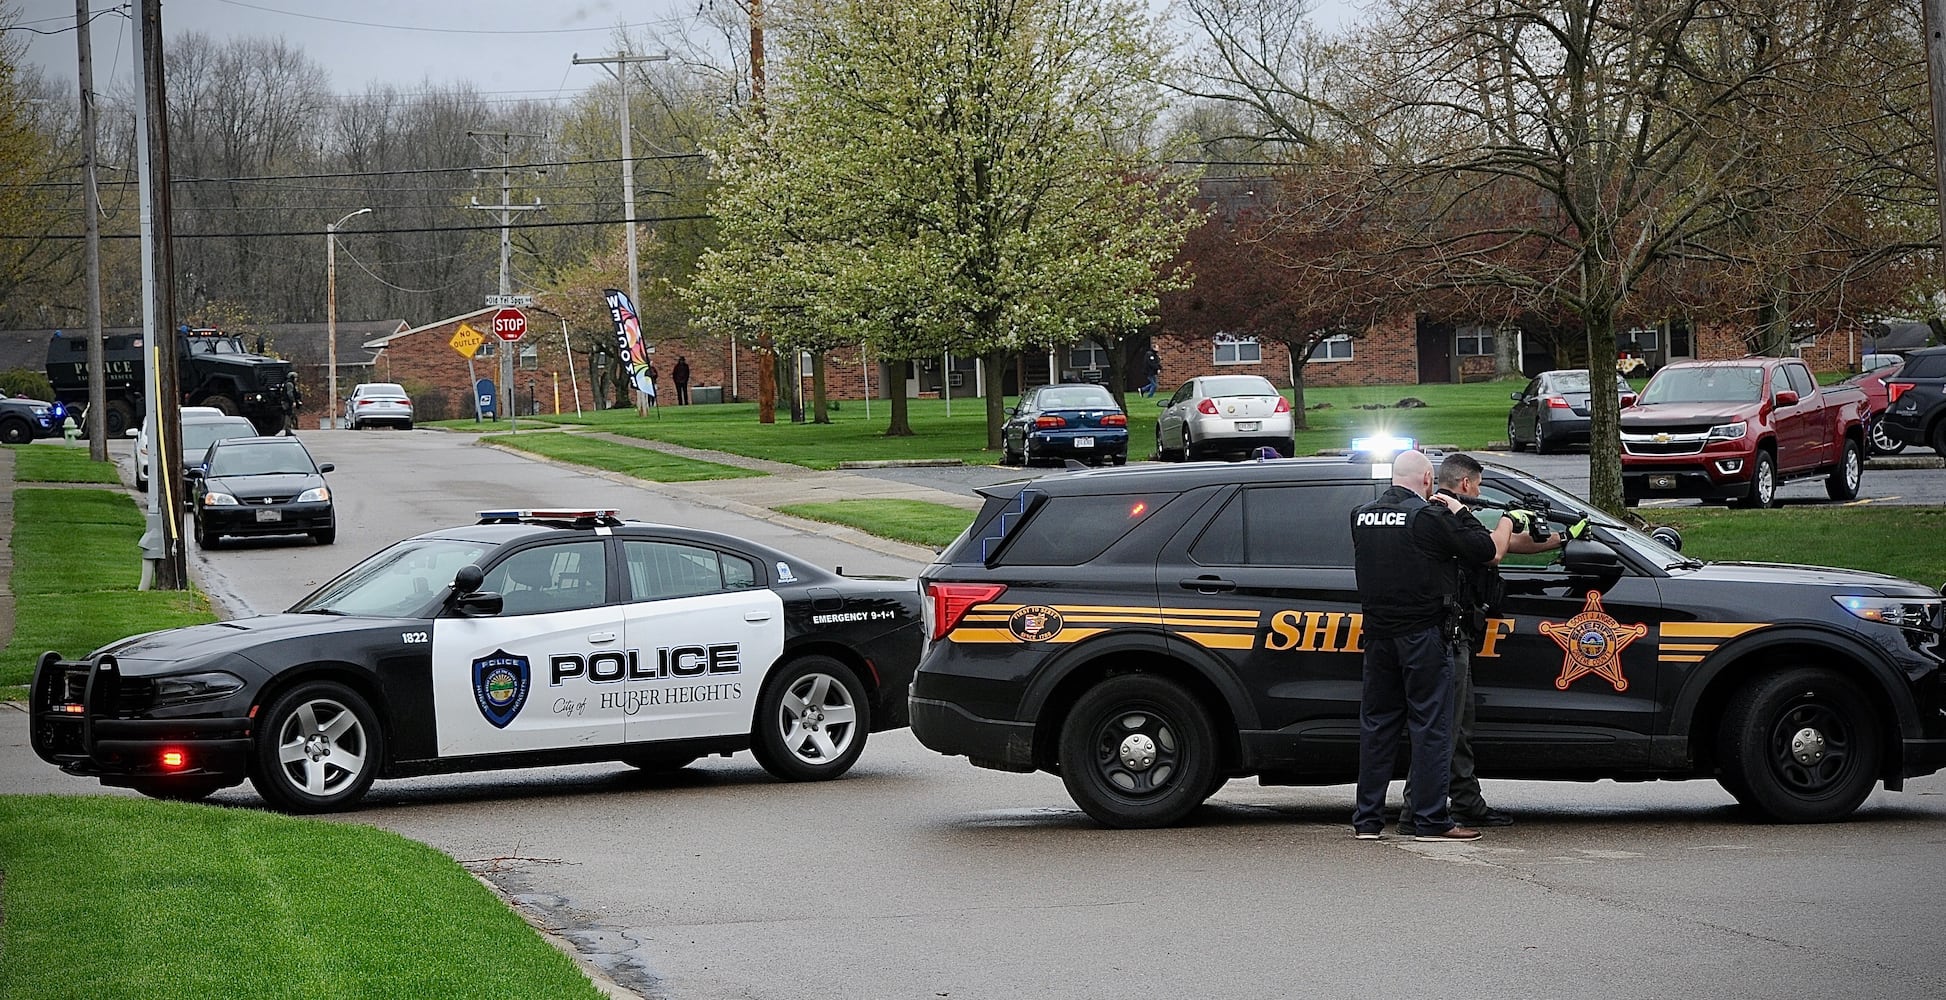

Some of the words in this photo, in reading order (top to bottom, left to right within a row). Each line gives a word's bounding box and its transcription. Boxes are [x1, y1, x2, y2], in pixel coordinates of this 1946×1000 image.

[495, 318, 524, 331] STOP
[453, 338, 480, 348] OUTLET
[74, 361, 132, 374] PICE
[1356, 512, 1407, 526] POLICE
[812, 612, 868, 624] EMERGENCY
[870, 610, 895, 620] 9-1-1
[1013, 608, 1030, 620] FIRST
[1040, 607, 1058, 620] SERVE
[1570, 613, 1588, 626] SCOTT
[1597, 613, 1616, 626] ANGER
[401, 632, 429, 644] 1822
[1020, 631, 1037, 640] SINCE
[1570, 622, 1615, 641] SHERIFF
[481, 659, 519, 668] POLICE
[1592, 650, 1611, 665] COUNTY
[549, 642, 742, 687] POLICE
[552, 698, 574, 717] City
[576, 697, 587, 716] of
[601, 689, 661, 715] HUBER
[665, 682, 742, 705] HEIGHTS
